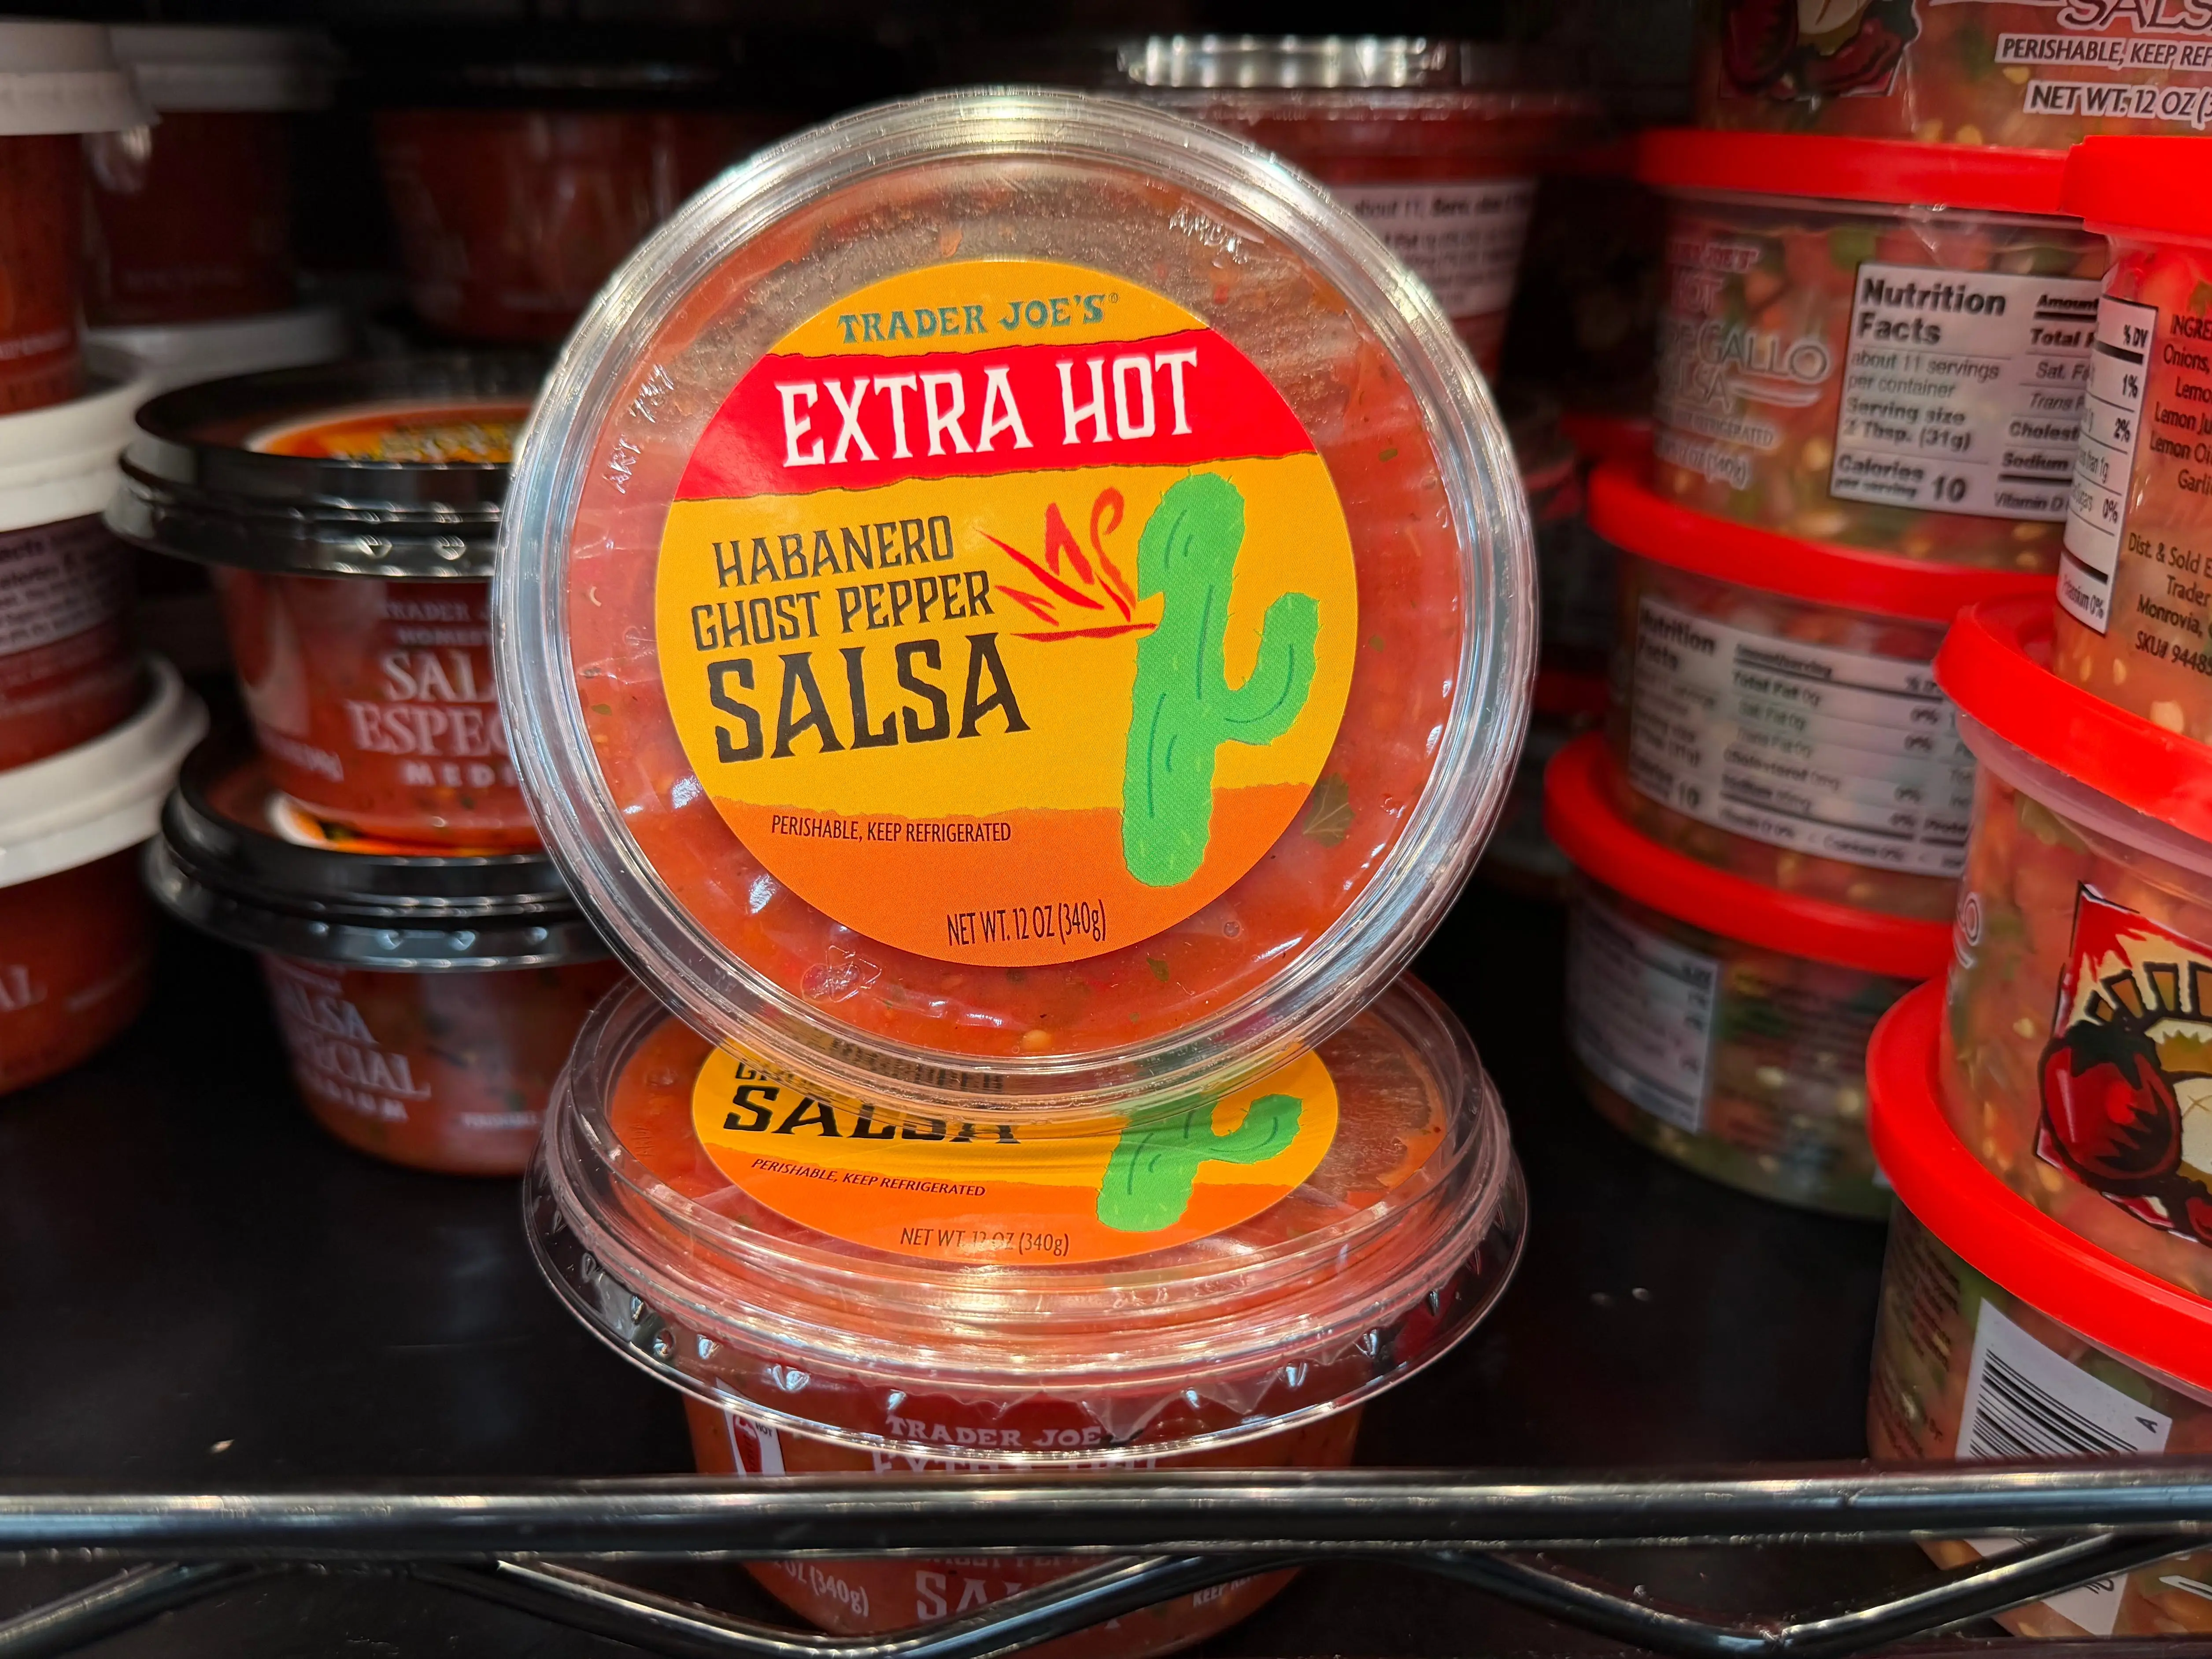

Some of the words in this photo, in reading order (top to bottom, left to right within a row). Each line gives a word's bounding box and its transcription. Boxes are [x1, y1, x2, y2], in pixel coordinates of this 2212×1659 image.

[2060, 0, 2212, 33] SALS
[2002, 38, 2124, 65] PERISHABLE,
[2130, 42, 2177, 65] KEEP
[2031, 85, 2080, 110] NET
[2086, 88, 2127, 113] WT.
[2134, 89, 2156, 114] 12
[2162, 91, 2197, 116] OZ
[1861, 278, 2007, 317] Nutrition
[837, 303, 988, 344] TRADER
[1857, 312, 1942, 344] Facts
[2030, 328, 2081, 347] Total
[1851, 351, 1895, 369] about
[1903, 356, 1920, 372] 11
[1926, 358, 2000, 383] servings
[2164, 344, 2210, 373] Onions,
[1847, 376, 1874, 392] per
[1878, 376, 1956, 398] container
[2122, 374, 2138, 398] 1%
[2175, 376, 2212, 404] Lemo
[776, 364, 1033, 467] EXTRA
[1057, 349, 1198, 446] HOT
[1846, 398, 1919, 425] Serving
[1926, 404, 1966, 425] size
[2029, 392, 2072, 411] Trans
[2154, 401, 2197, 431] Lemon
[1919, 427, 1972, 451] (31g)
[2114, 417, 2131, 443] 2%
[2149, 430, 2191, 460] Lemon
[1837, 454, 1924, 483] Calories
[2002, 452, 2069, 472] Sodium
[1932, 473, 1967, 503] 10
[2102, 498, 2118, 524] 0%
[712, 515, 954, 588] HABANERO
[2156, 543, 2165, 564] &
[2168, 546, 2201, 574] Sold
[2167, 574, 2211, 608] Trader
[691, 591, 821, 652] GHOST
[835, 570, 995, 633] PEPPER
[2137, 594, 2203, 639] Monrovia,
[707, 632, 1031, 763] SALSA
[772, 815, 862, 843] PERISHABLE,
[867, 821, 902, 842] KEEP
[906, 822, 1011, 842] REFRIGERATED
[947, 912, 976, 946] NET
[980, 910, 1010, 943] WT.
[1013, 907, 1029, 940] 12
[1033, 905, 1055, 938] OZ
[1059, 899, 1106, 945] (340g)
[751, 1158, 838, 1182] PERISHABLE,
[843, 1172, 878, 1186] KEEP
[880, 1178, 986, 1197] REFRIGERATED
[900, 1227, 934, 1246] NET
[1019, 1232, 1069, 1257] (340g)
[755, 1421, 773, 1437] HOT
[886, 1415, 1022, 1446] TRADER
[810, 1565, 869, 1618] (340g)
